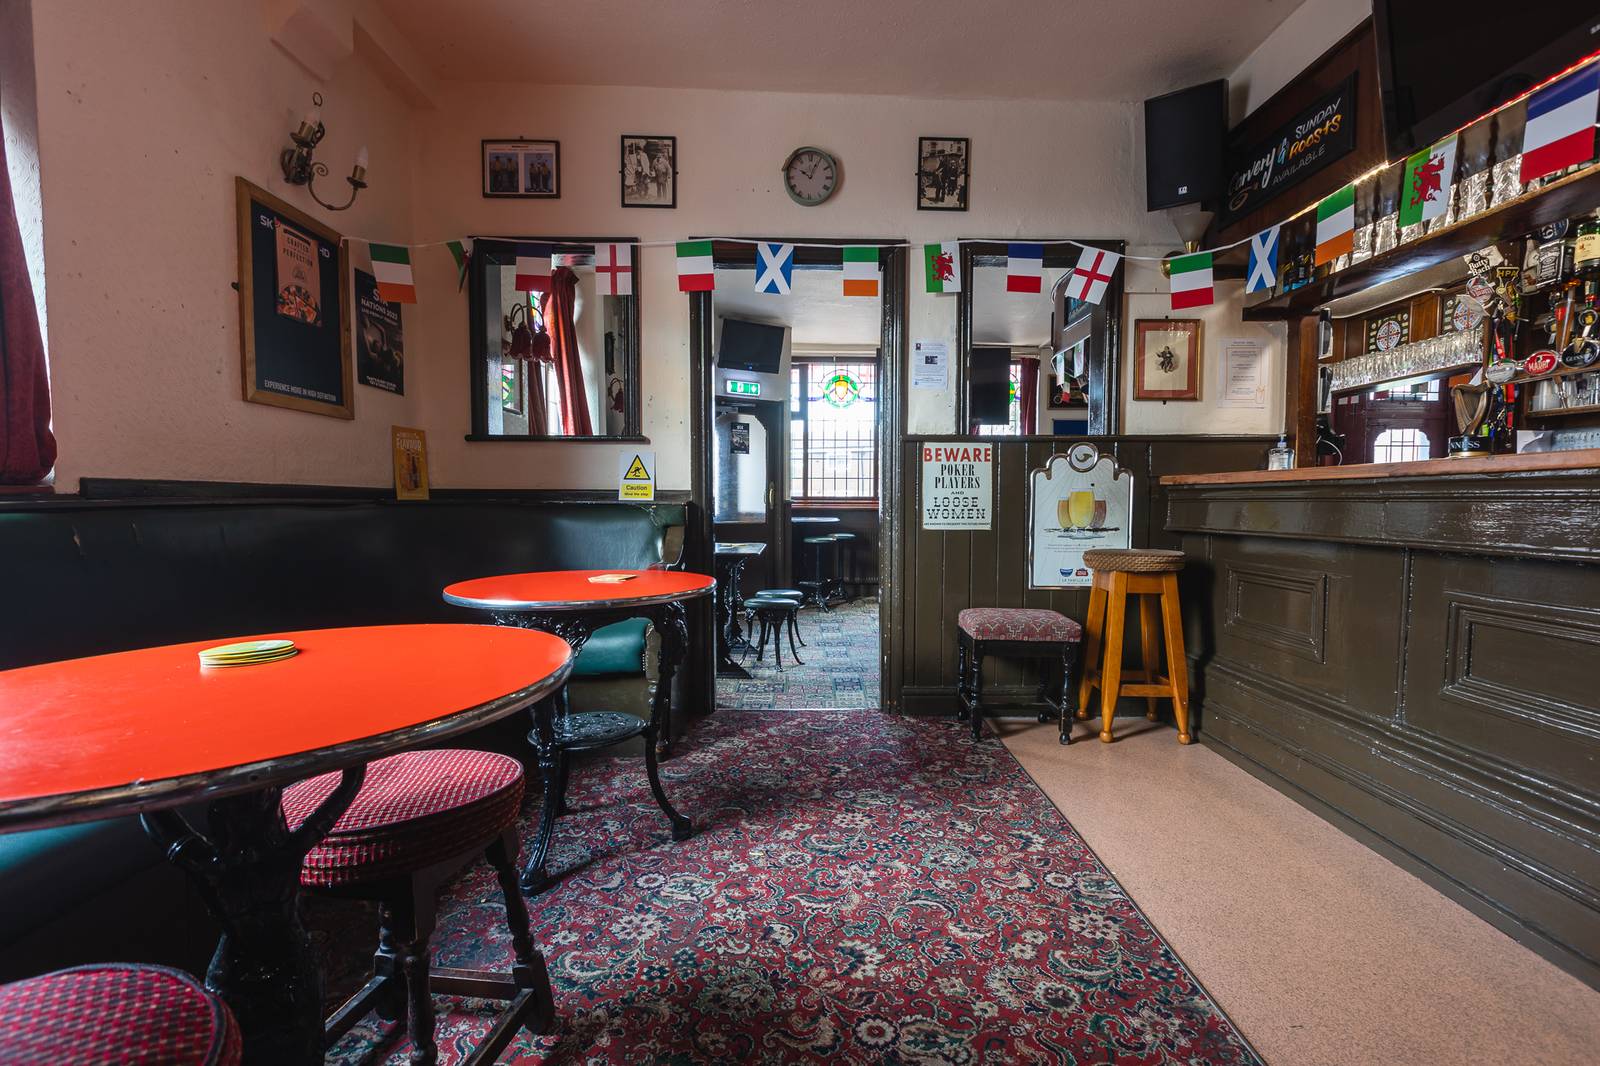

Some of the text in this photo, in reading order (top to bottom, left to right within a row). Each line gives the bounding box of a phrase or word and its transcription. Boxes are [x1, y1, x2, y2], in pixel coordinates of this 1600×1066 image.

[1295, 97, 1341, 139] SUNDAY
[1273, 144, 1325, 185] AVAILABLE
[260, 215, 274, 230] SK
[924, 447, 991, 463] BEWARE
[941, 463, 975, 476] POKER
[935, 476, 981, 489] PLAYERS
[934, 496, 979, 507] LOOSE
[926, 508, 987, 519] WOMEN
